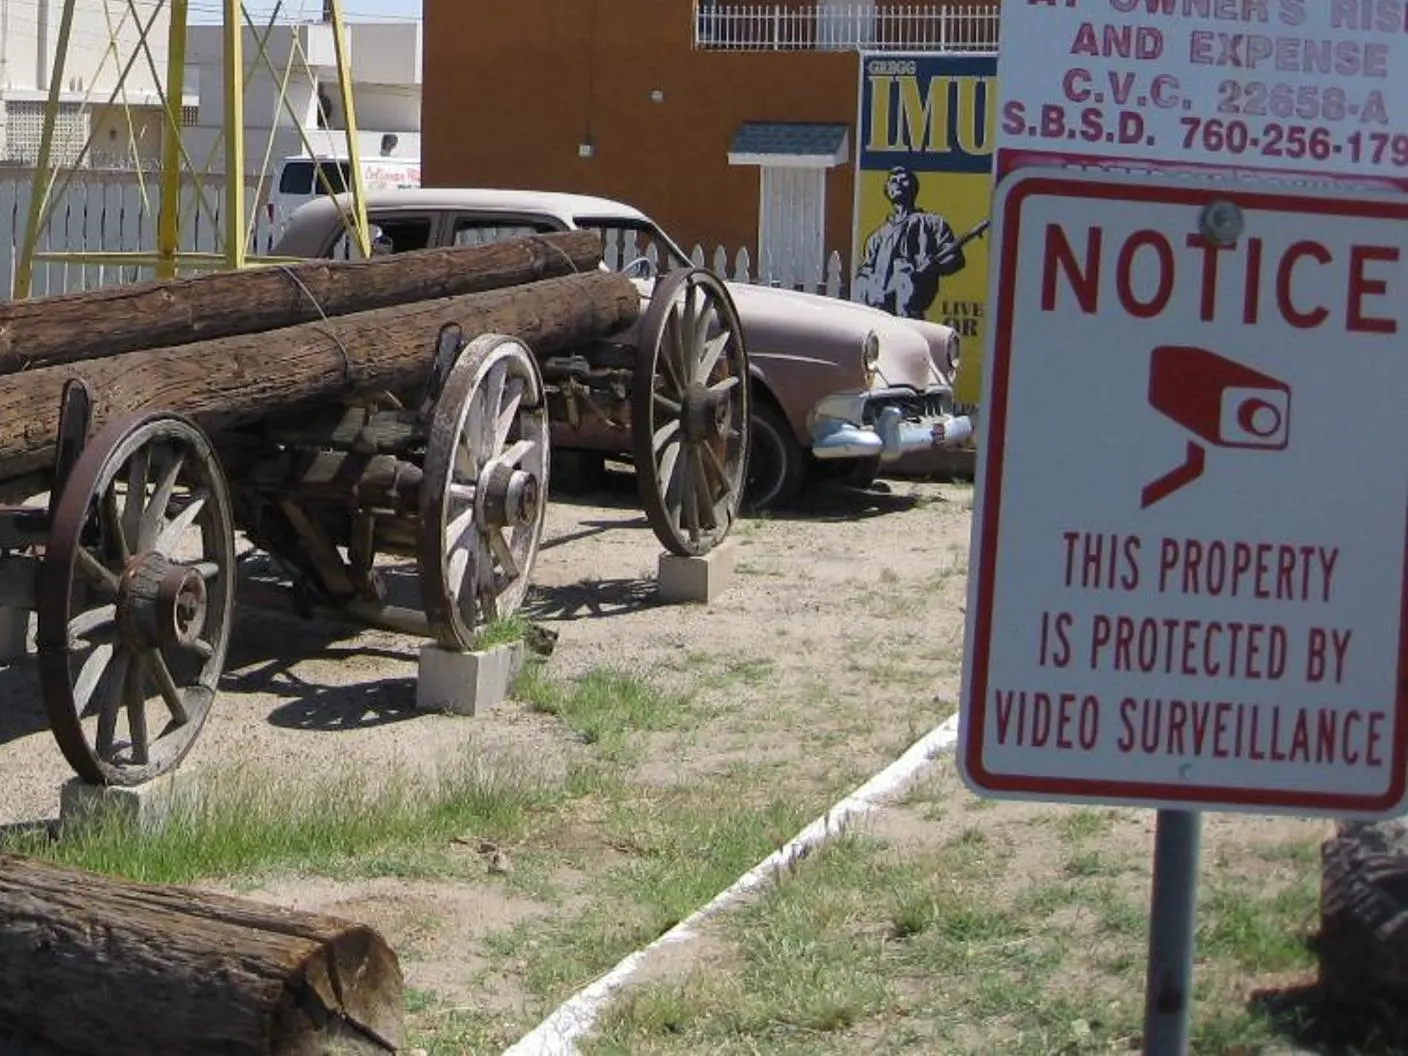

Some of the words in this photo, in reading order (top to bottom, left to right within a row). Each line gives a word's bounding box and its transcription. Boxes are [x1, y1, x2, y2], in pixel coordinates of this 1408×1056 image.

[1069, 21, 1165, 61] AND
[1189, 30, 1390, 78] EXPENSE
[1001, 99, 1156, 147] S.B.S.D.
[1062, 67, 1192, 111] C.V.C.
[1217, 79, 1390, 126] 22658-A
[941, 300, 984, 318] LIVE
[1040, 223, 1400, 335] NOTICE
[1063, 530, 1141, 592] THIS
[1159, 537, 1339, 603] PROPERTY
[1039, 610, 1073, 669] IS
[1091, 614, 1286, 681] PROTECTED
[1306, 627, 1352, 684] BY
[995, 689, 1100, 750] VIDEO
[1118, 696, 1386, 768] SURVEILLANCE
